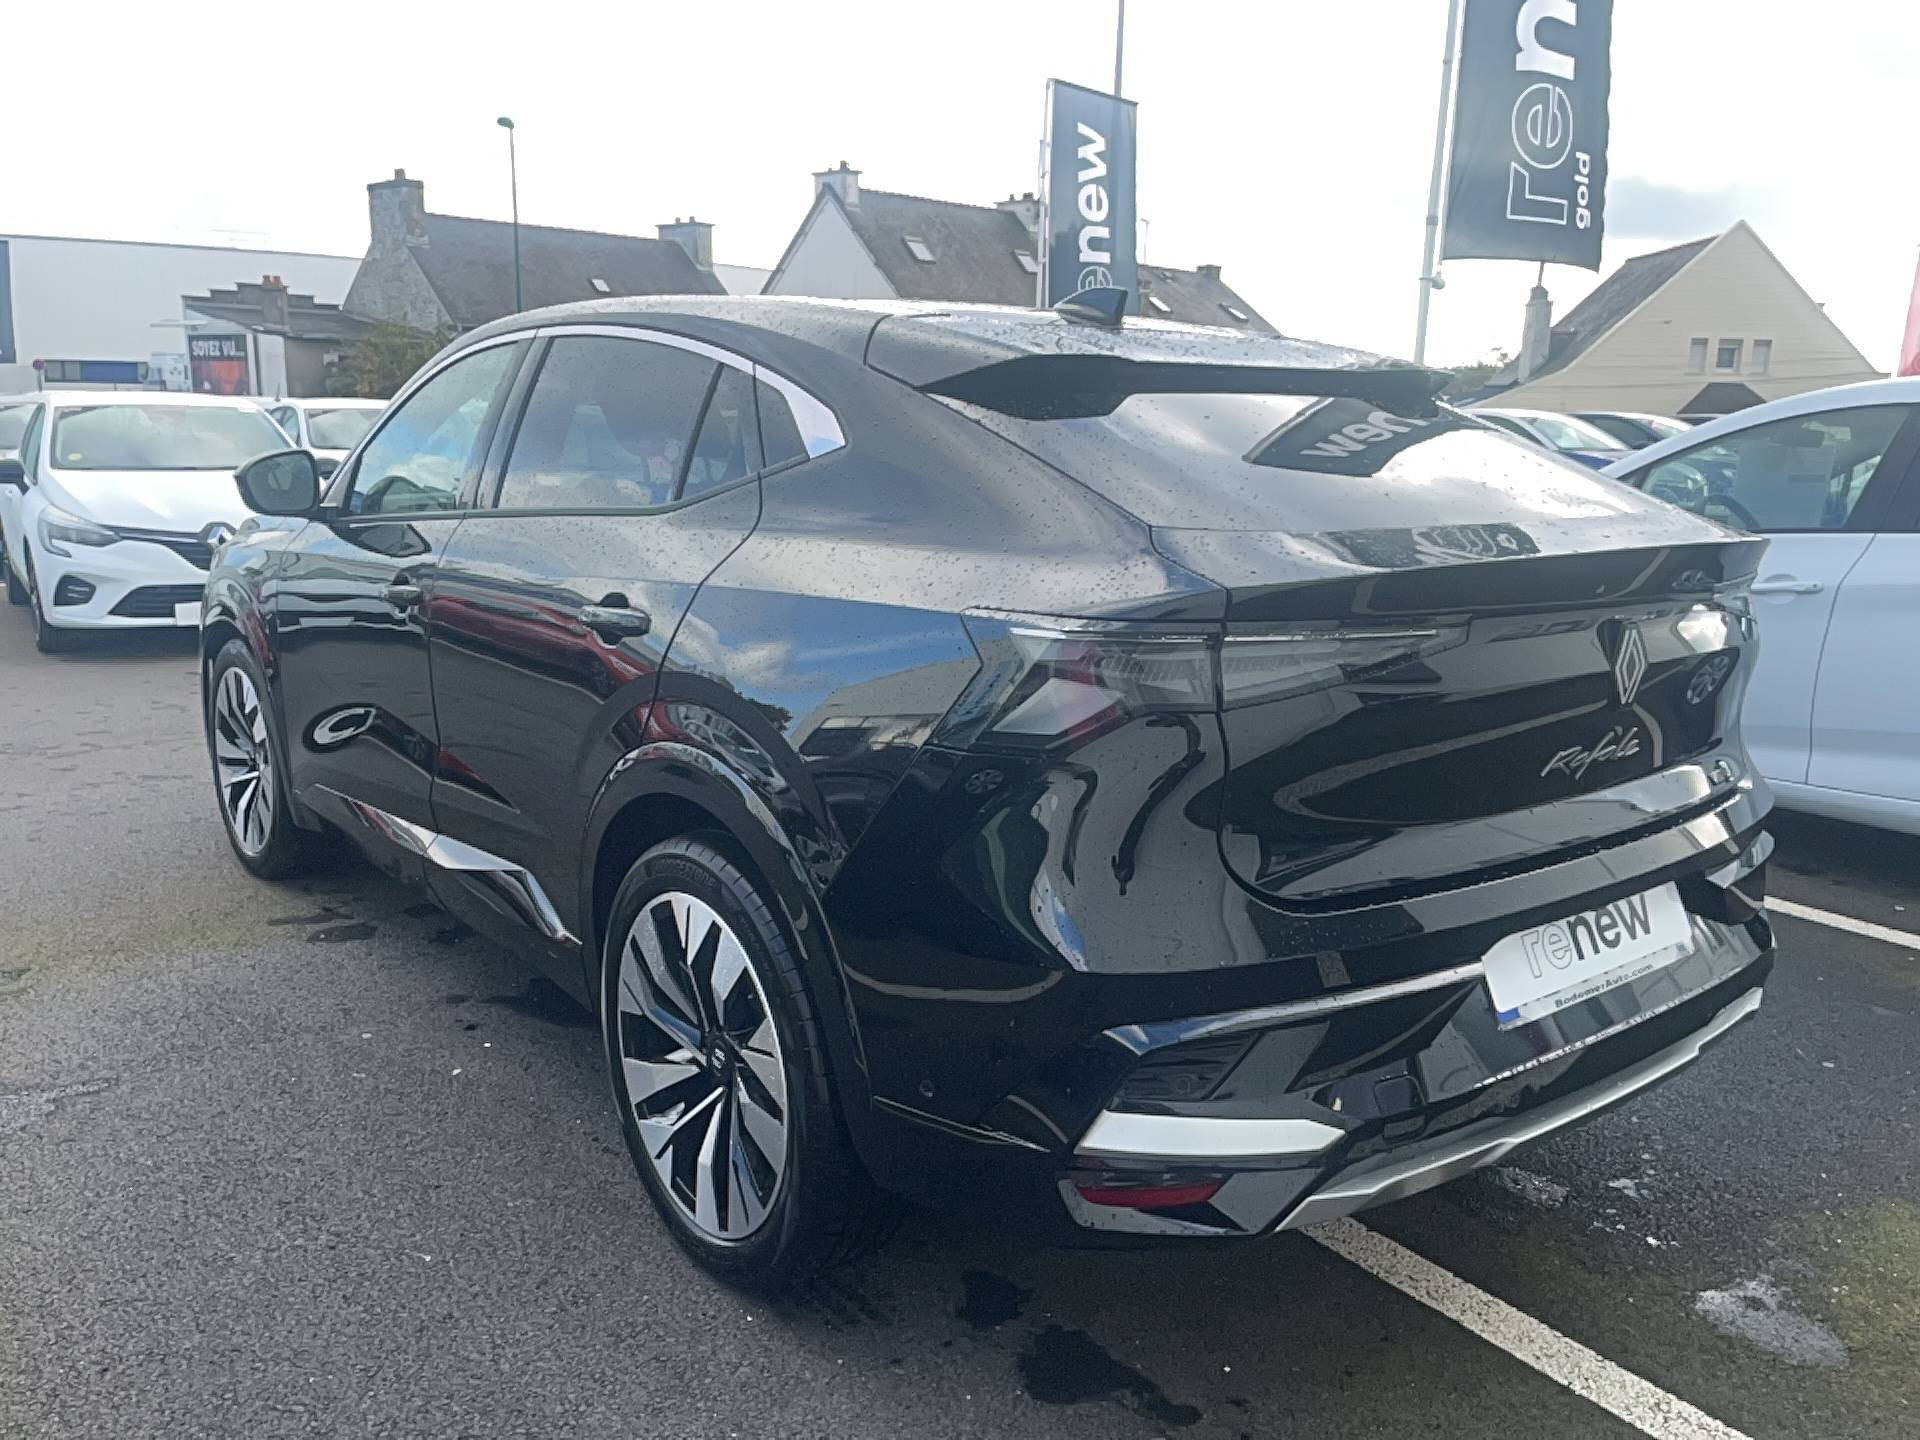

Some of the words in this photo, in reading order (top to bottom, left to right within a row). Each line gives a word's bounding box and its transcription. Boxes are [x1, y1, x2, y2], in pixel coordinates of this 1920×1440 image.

[1507, 0, 1577, 225] ren
[1077, 121, 1113, 291] enew
[1574, 151, 1592, 230] gold
[191, 339, 220, 356] SOYEZ
[1521, 893, 1651, 979] renew
